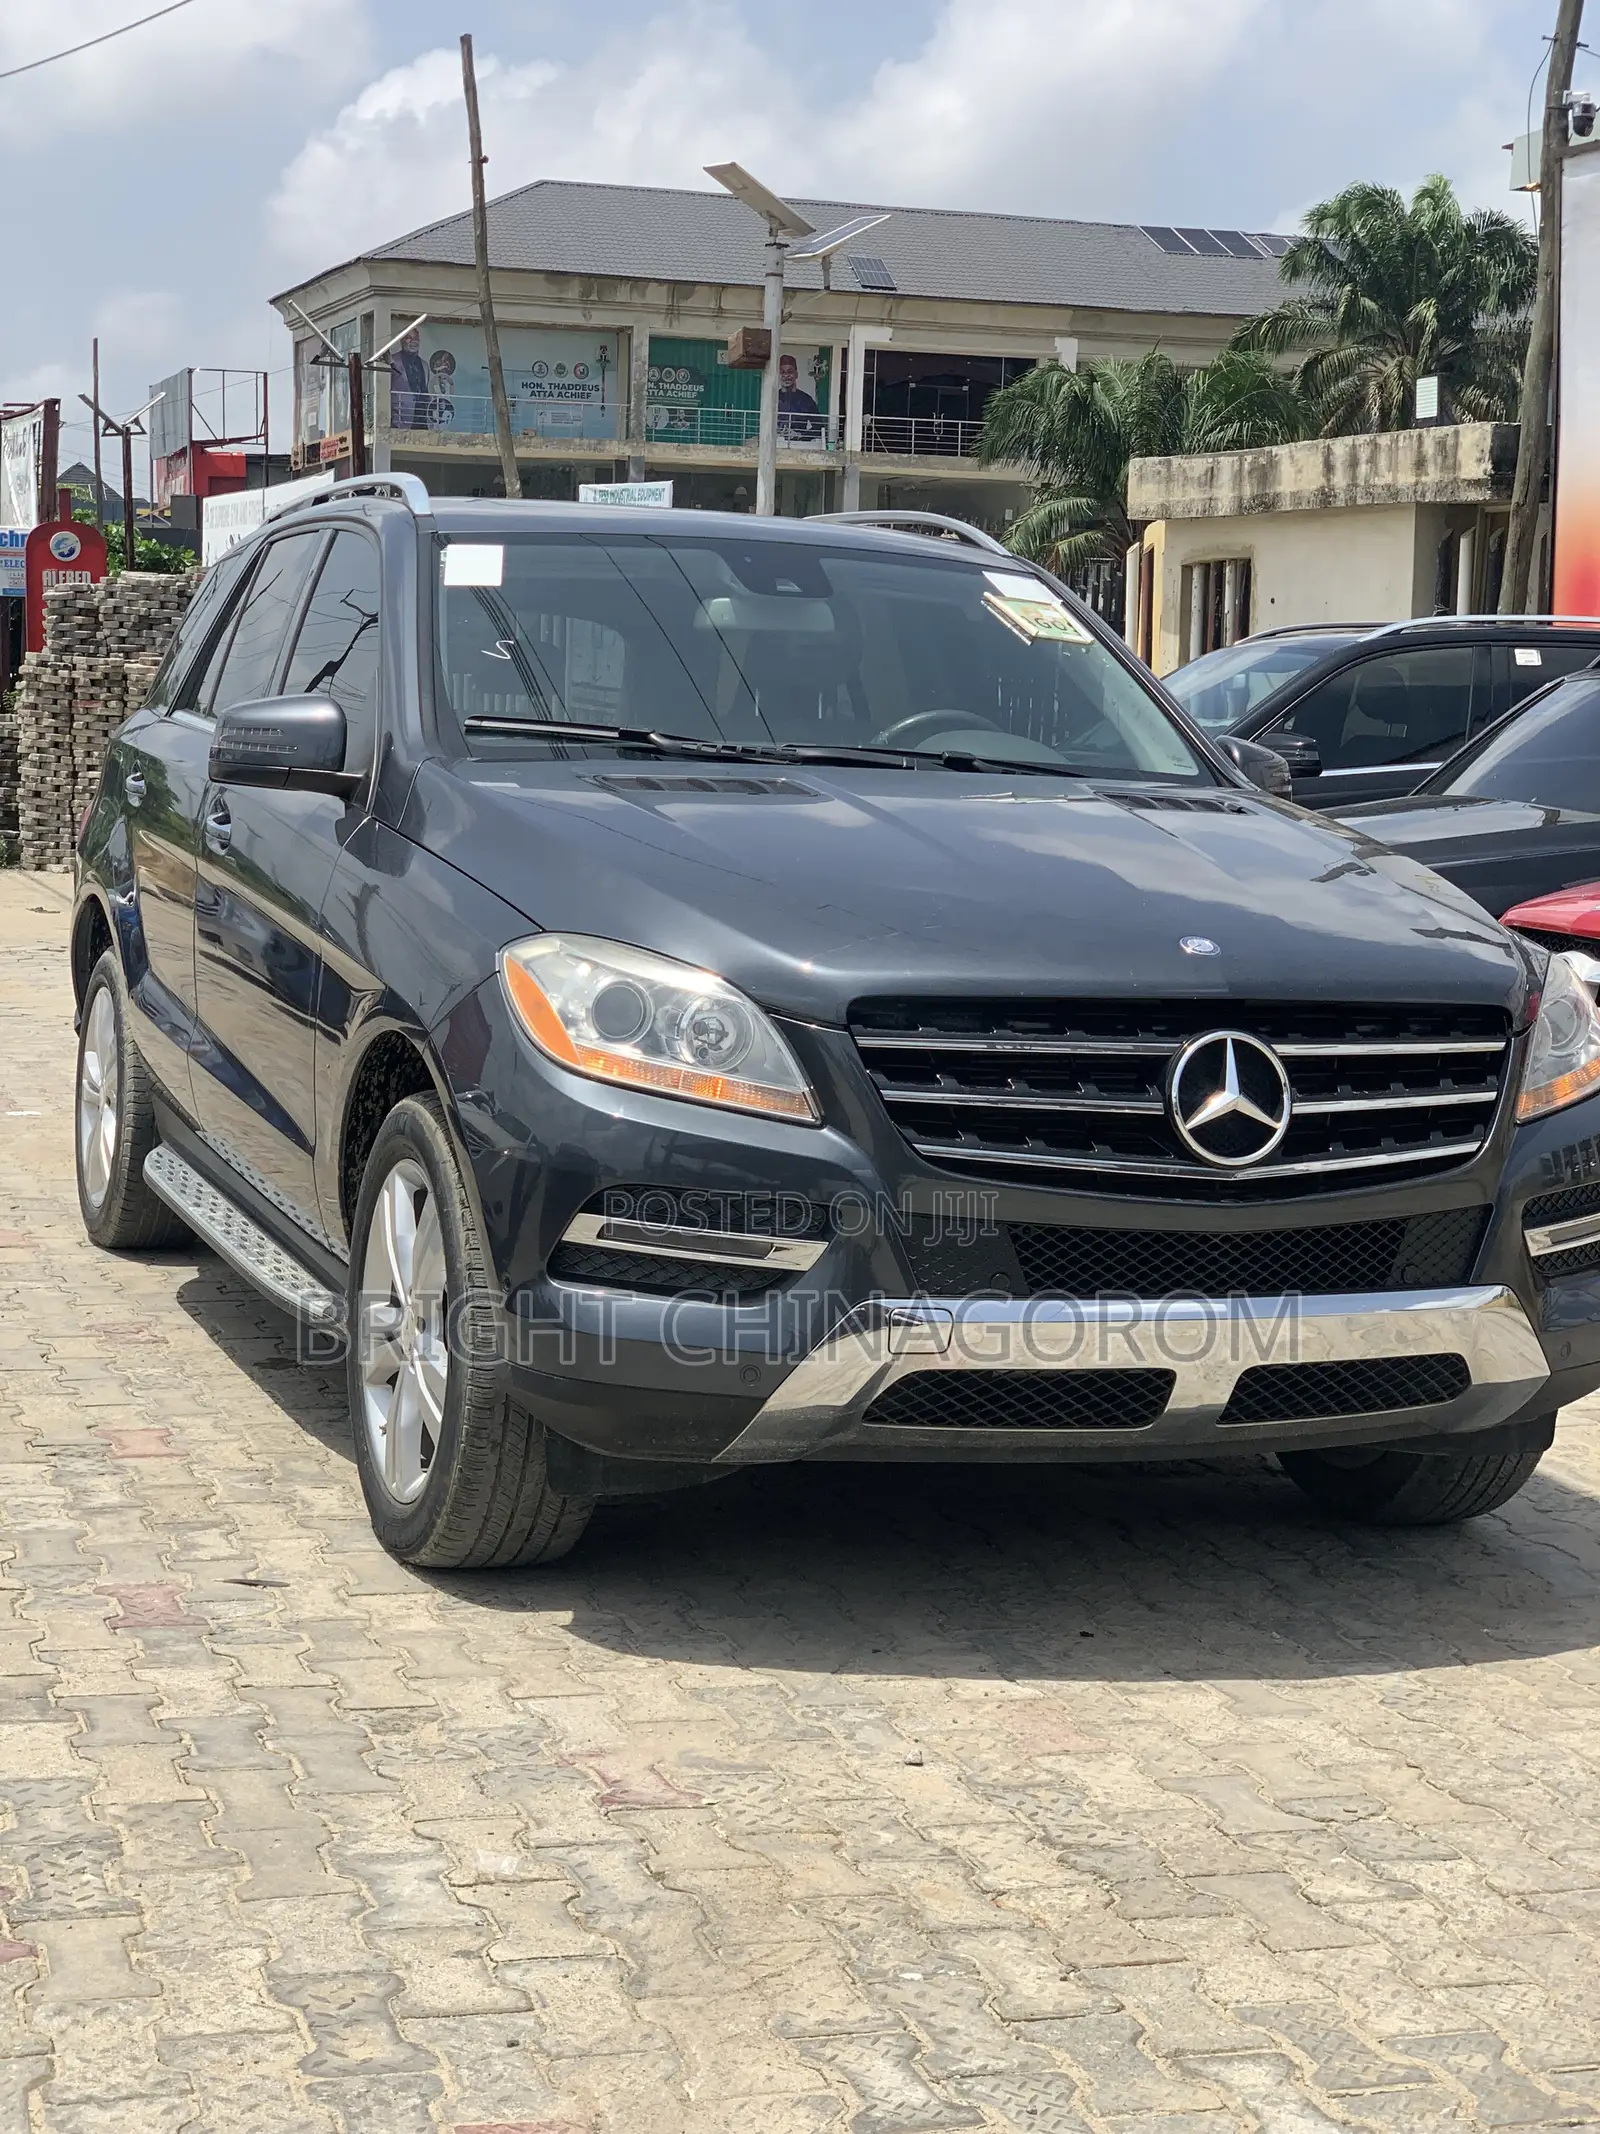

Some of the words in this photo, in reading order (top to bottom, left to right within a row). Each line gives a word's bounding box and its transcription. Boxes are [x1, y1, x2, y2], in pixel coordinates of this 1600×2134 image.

[521, 381, 545, 390] HON.
[548, 382, 600, 392] THADDEUS
[658, 382, 705, 392] THADDEUS
[529, 390, 555, 398] ATTA
[557, 391, 592, 399] ACHIEF
[666, 390, 697, 398] ACHIEF
